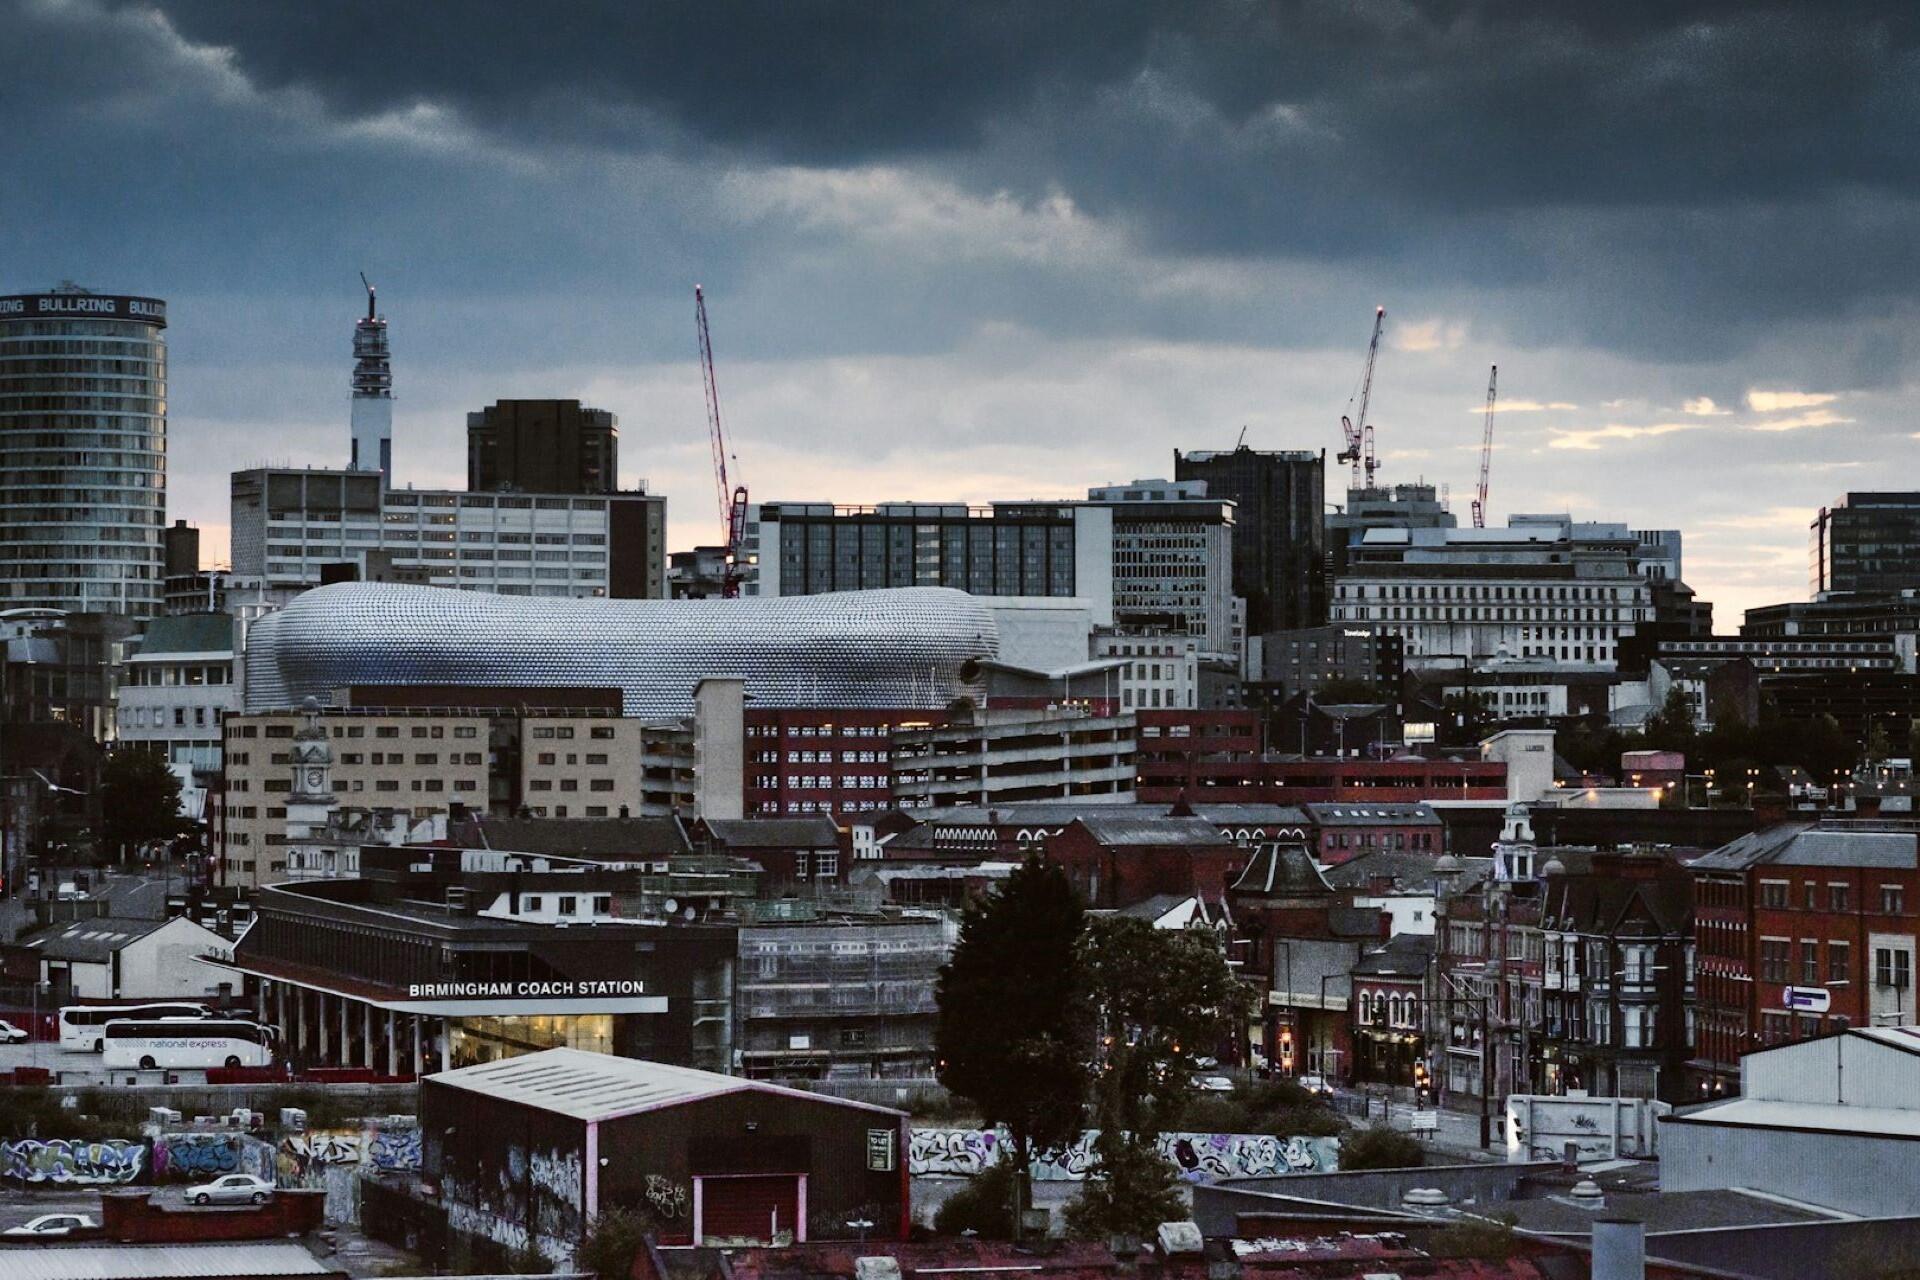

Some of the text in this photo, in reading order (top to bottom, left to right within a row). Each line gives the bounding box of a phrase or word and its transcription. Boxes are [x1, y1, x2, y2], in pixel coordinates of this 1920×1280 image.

[39, 298, 115, 312] BULLRING
[409, 981, 644, 997] BIRMINGHAM COACH STATION
[150, 1039, 228, 1049] national express
